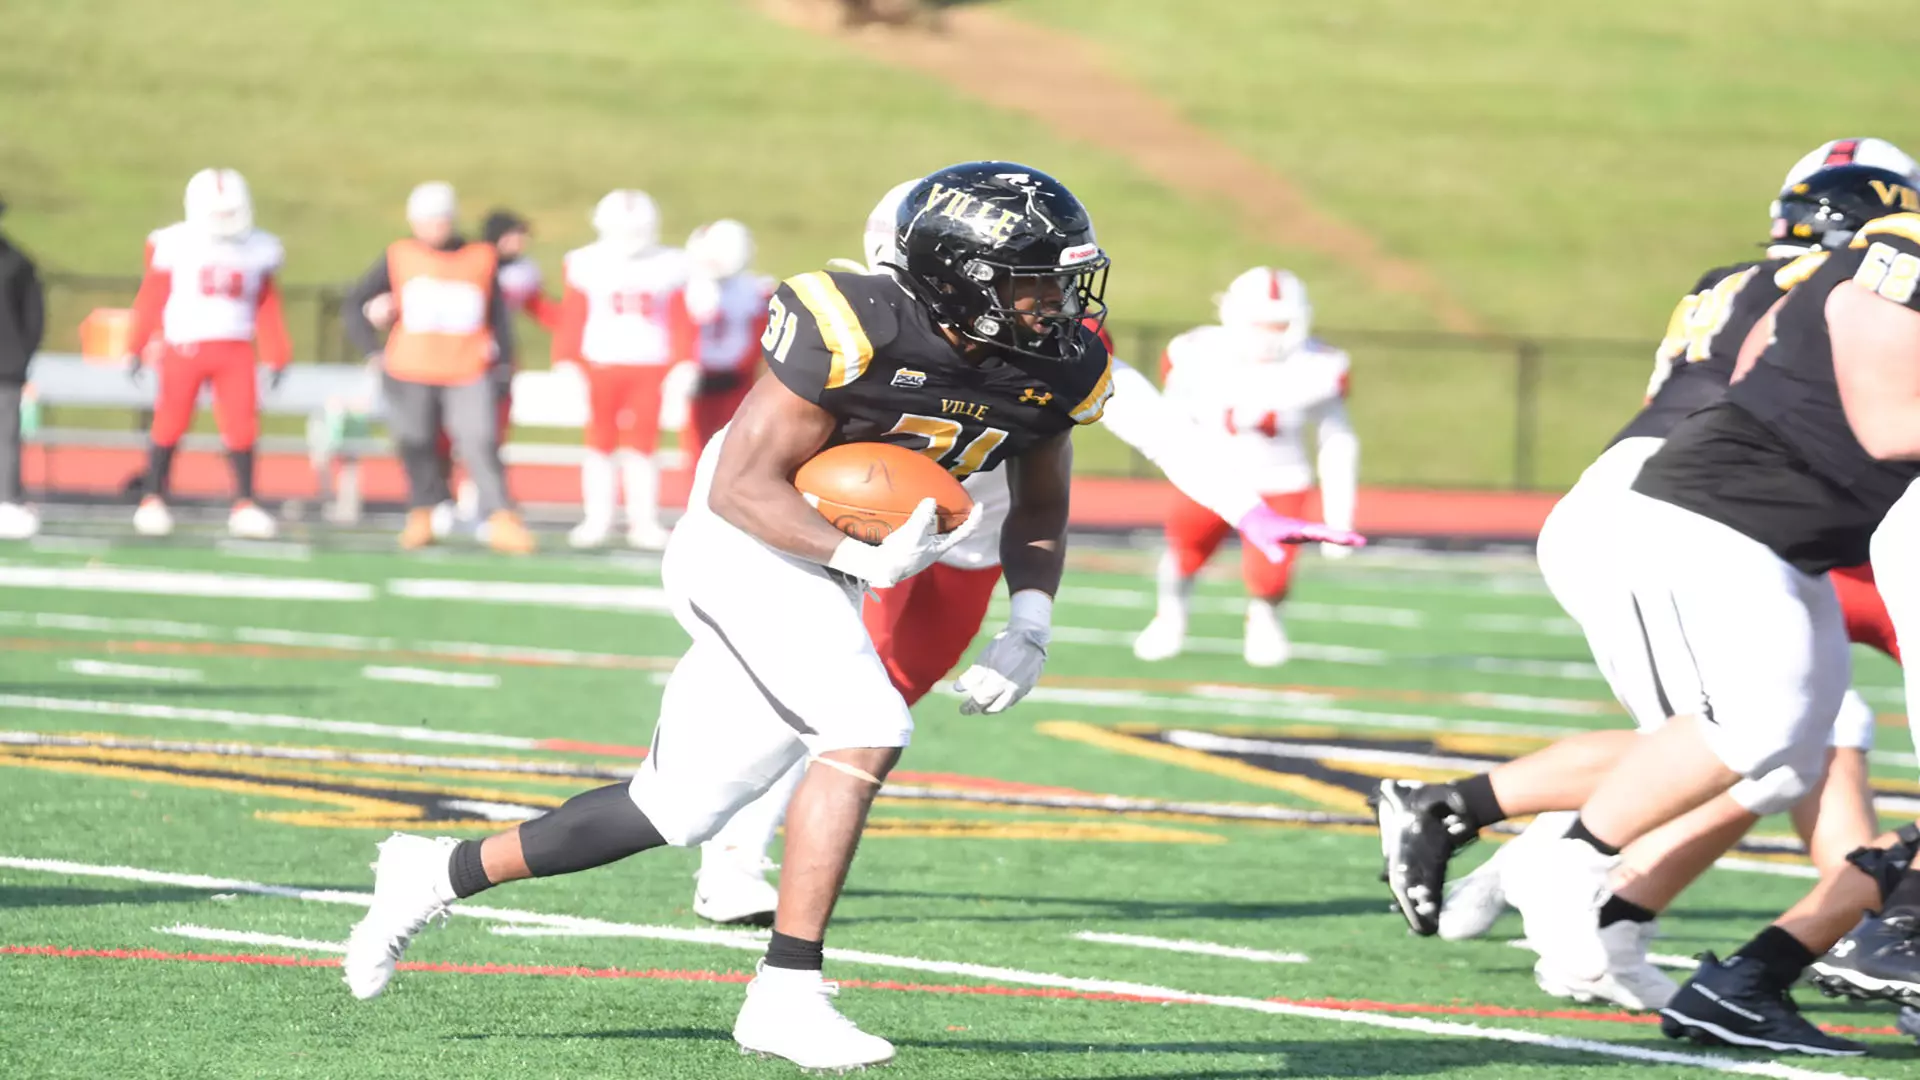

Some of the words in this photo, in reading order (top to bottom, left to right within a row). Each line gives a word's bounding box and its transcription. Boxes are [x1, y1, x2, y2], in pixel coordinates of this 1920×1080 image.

[926, 183, 1024, 241] VILLE
[761, 294, 797, 363] 31
[941, 398, 989, 421] VILLE
